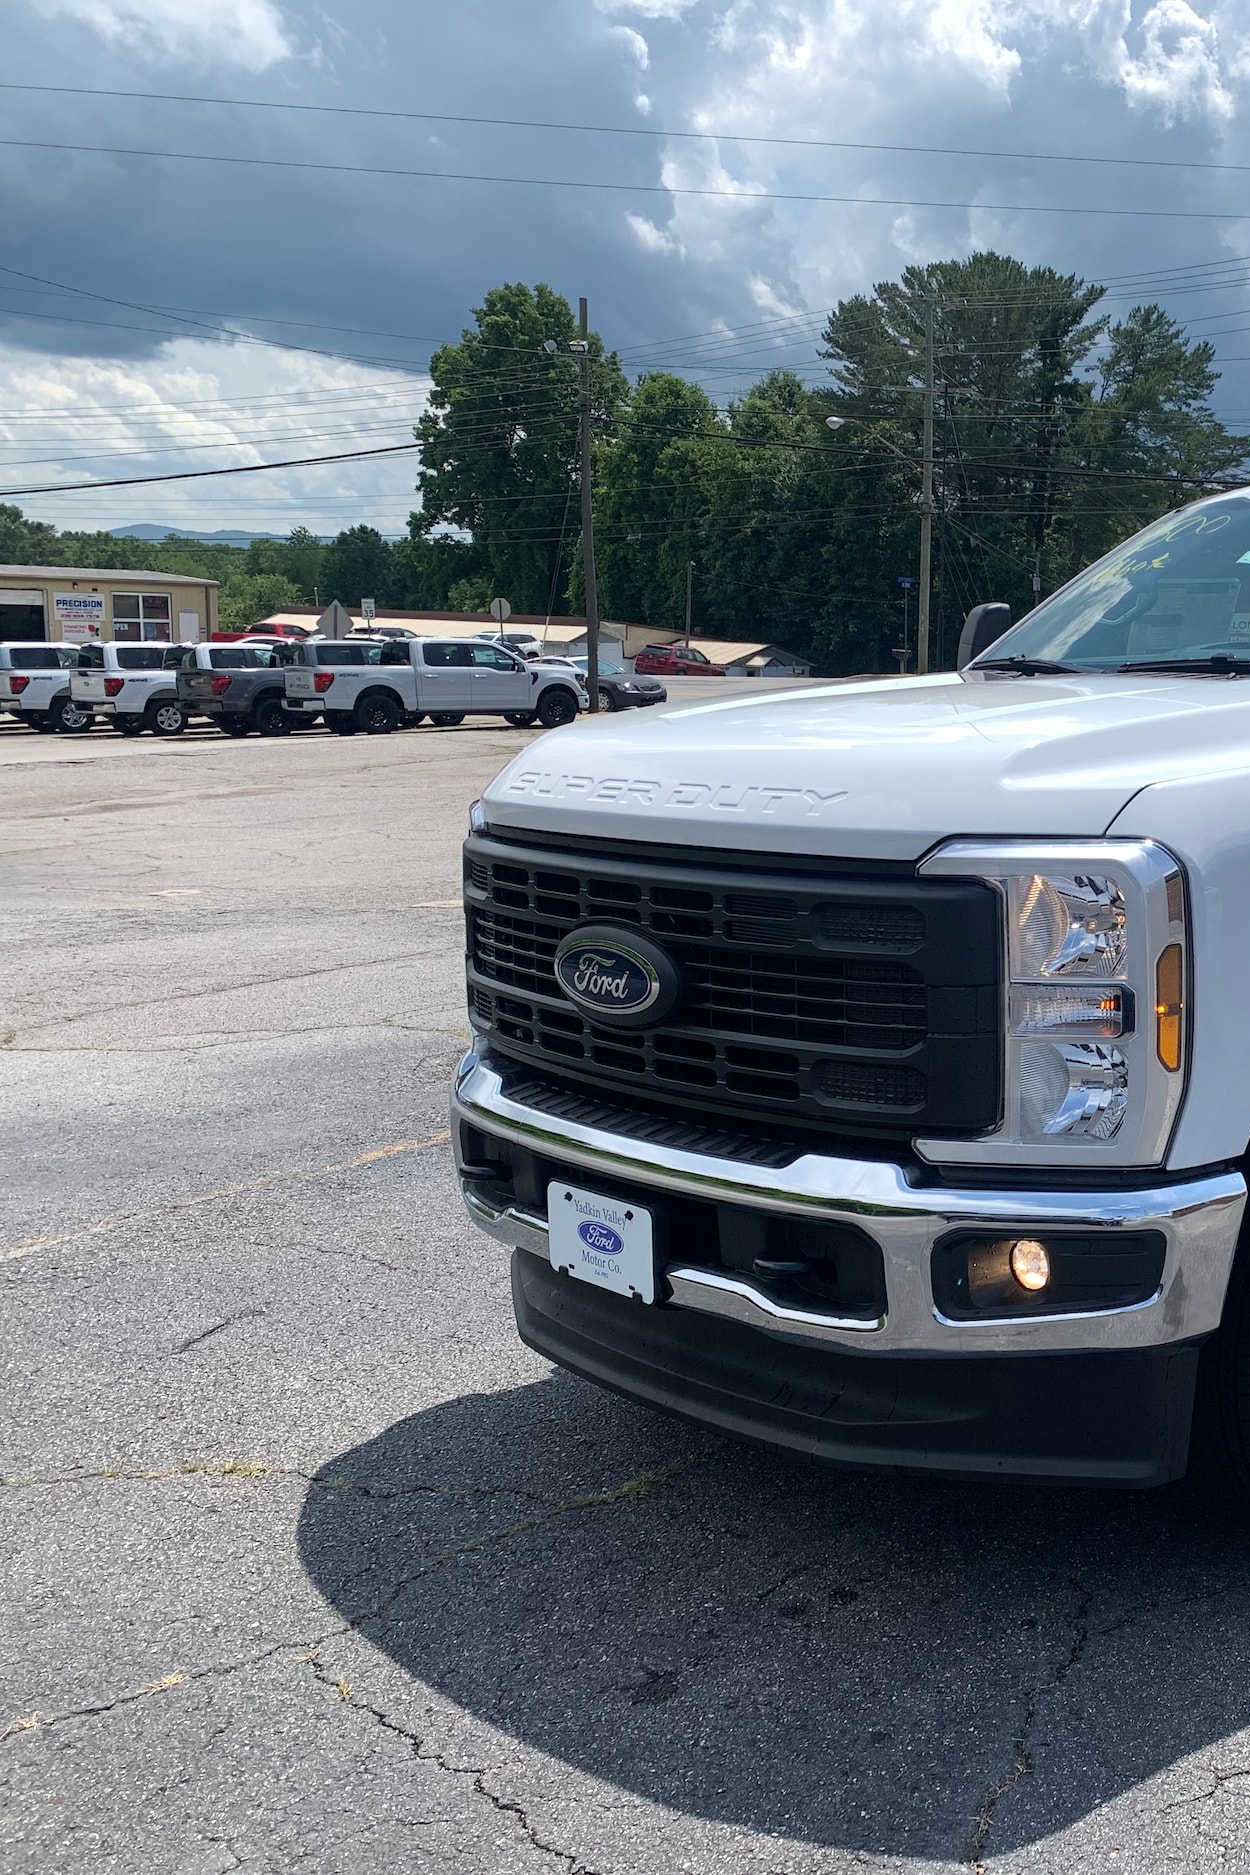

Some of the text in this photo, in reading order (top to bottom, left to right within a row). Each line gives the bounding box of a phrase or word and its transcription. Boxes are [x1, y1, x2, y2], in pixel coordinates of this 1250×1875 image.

[56, 599, 103, 608] PRECISION
[363, 609, 374, 618] 35
[506, 771, 850, 817] SUPER DUTY
[573, 952, 630, 999] Ford
[574, 1199, 627, 1231] Yadkin Valley
[586, 1224, 615, 1251] Ford
[581, 1250, 605, 1269] Motor
[607, 1258, 622, 1275] Co.
